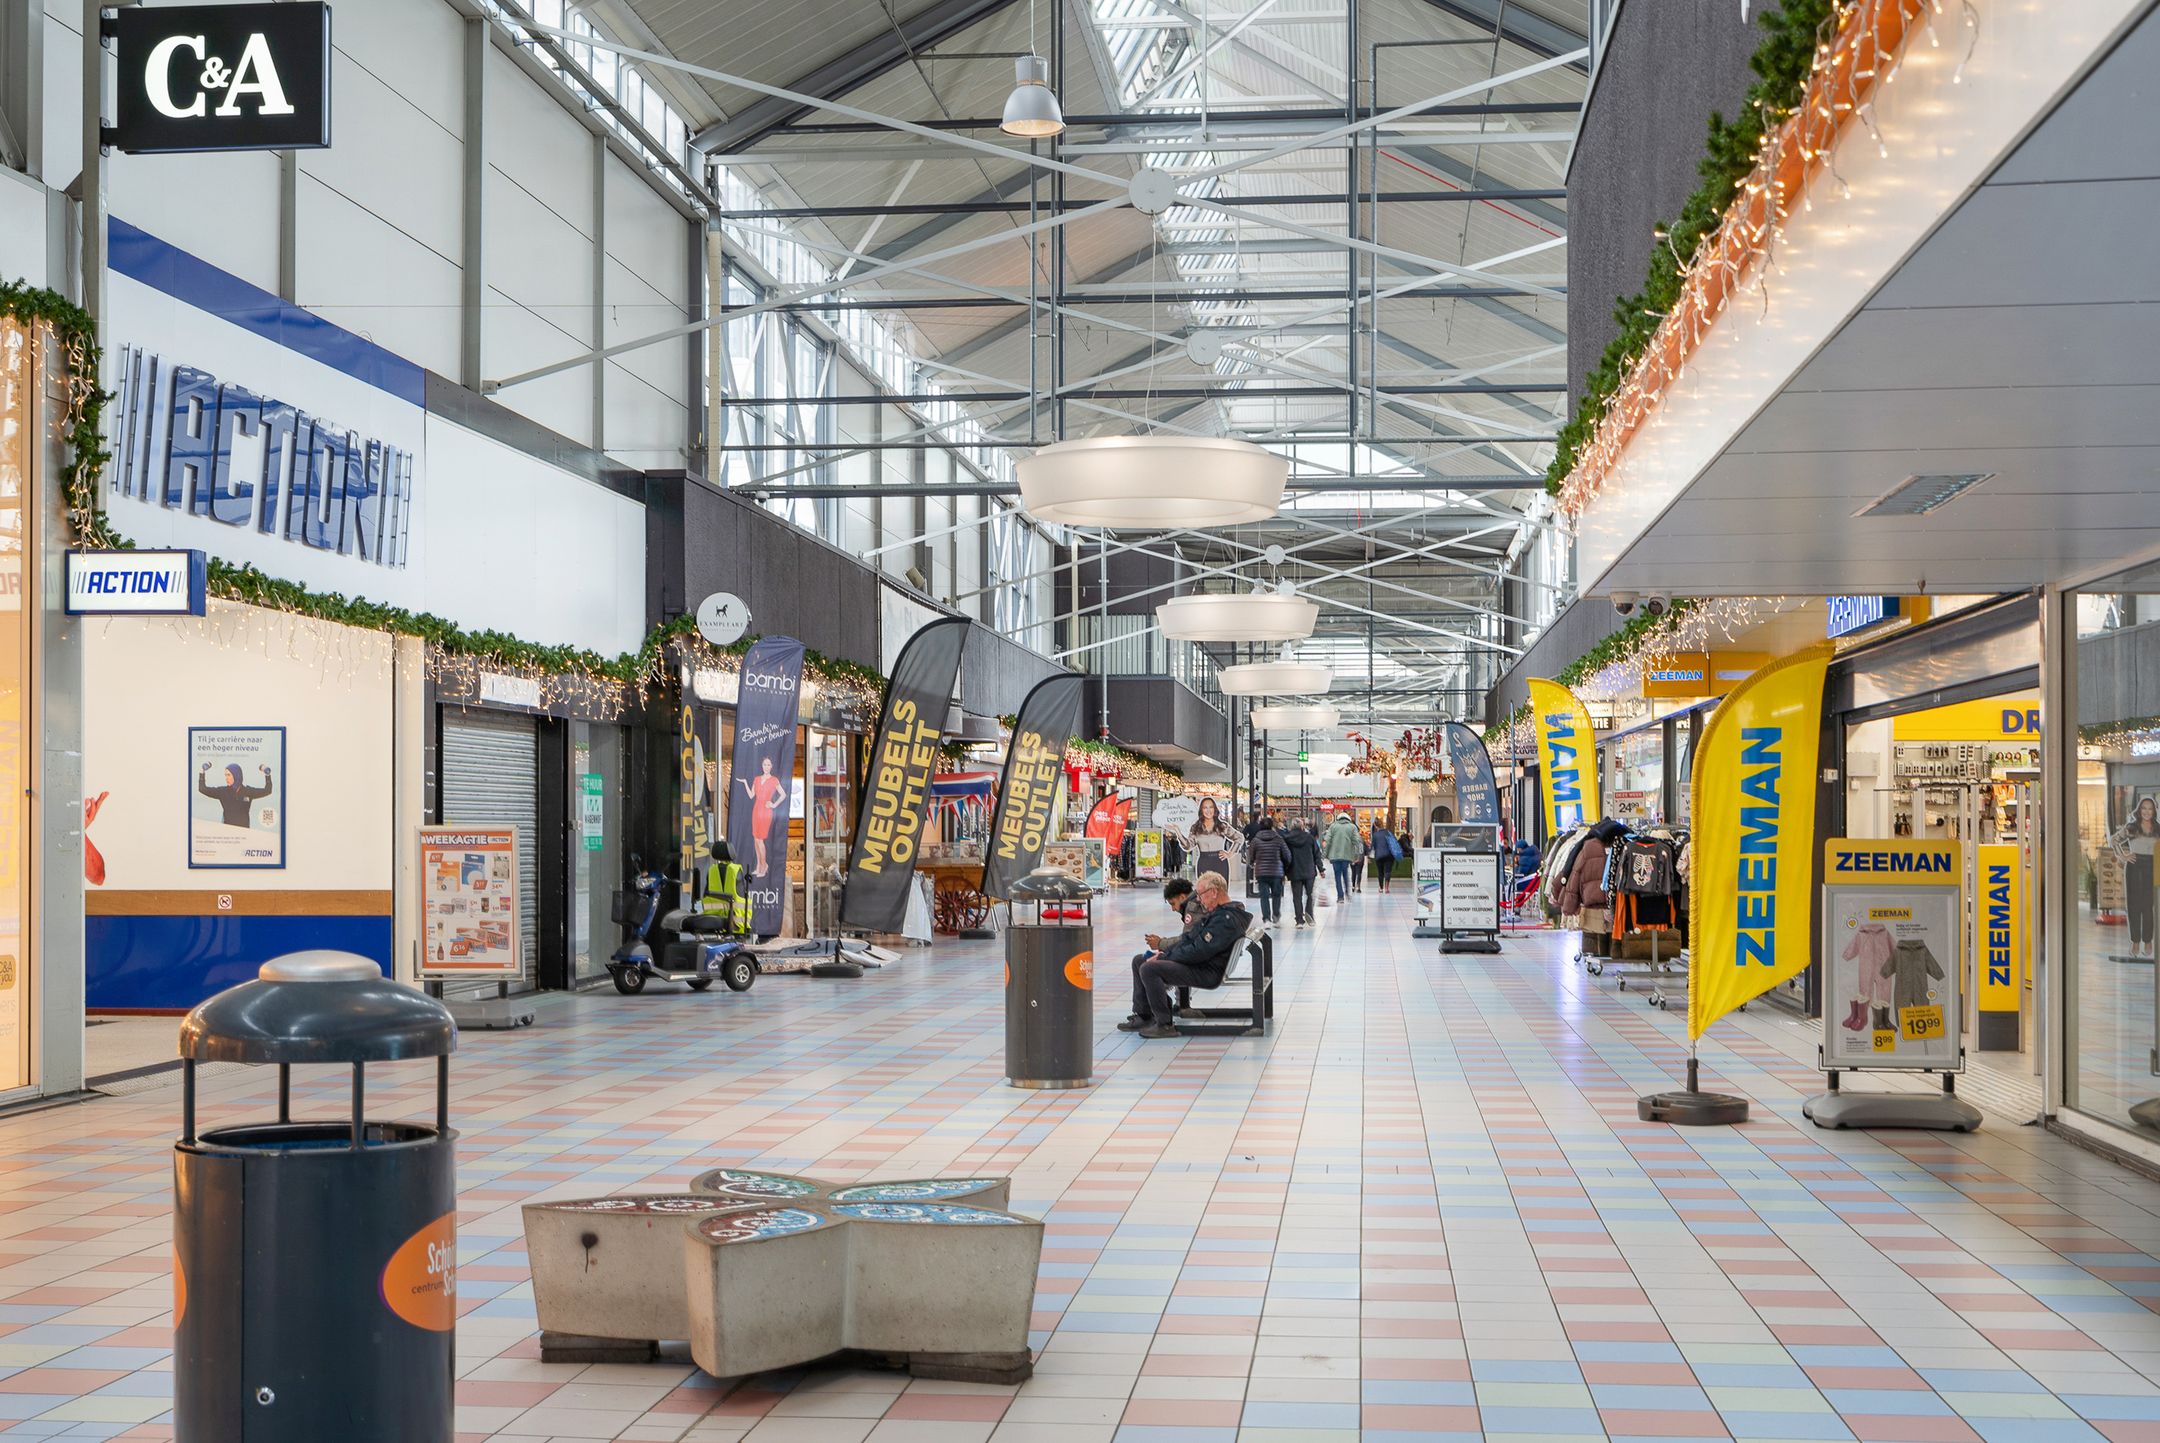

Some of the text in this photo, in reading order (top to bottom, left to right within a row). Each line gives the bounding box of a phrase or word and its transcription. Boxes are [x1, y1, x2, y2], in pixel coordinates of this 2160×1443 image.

[144, 32, 294, 118] C&A
[165, 364, 385, 563] ACTION
[87, 571, 170, 593] ACTION
[745, 669, 796, 692] bambi
[1650, 671, 1703, 680] ZEEMAN
[212, 744, 233, 752] hoger
[858, 699, 917, 873] MEUBELS
[890, 719, 940, 863] OUTLET
[998, 731, 1042, 860] MEUBELS
[1022, 746, 1059, 853] OUTLET
[244, 849, 273, 857] ACTION
[425, 834, 489, 845] WEEKACTIE
[1735, 726, 1783, 967] ZEEMAN
[1835, 851, 1952, 873] ZEEMAN
[1872, 910, 1910, 918] ZEEMAN
[1988, 865, 2010, 987] ZEEMAN
